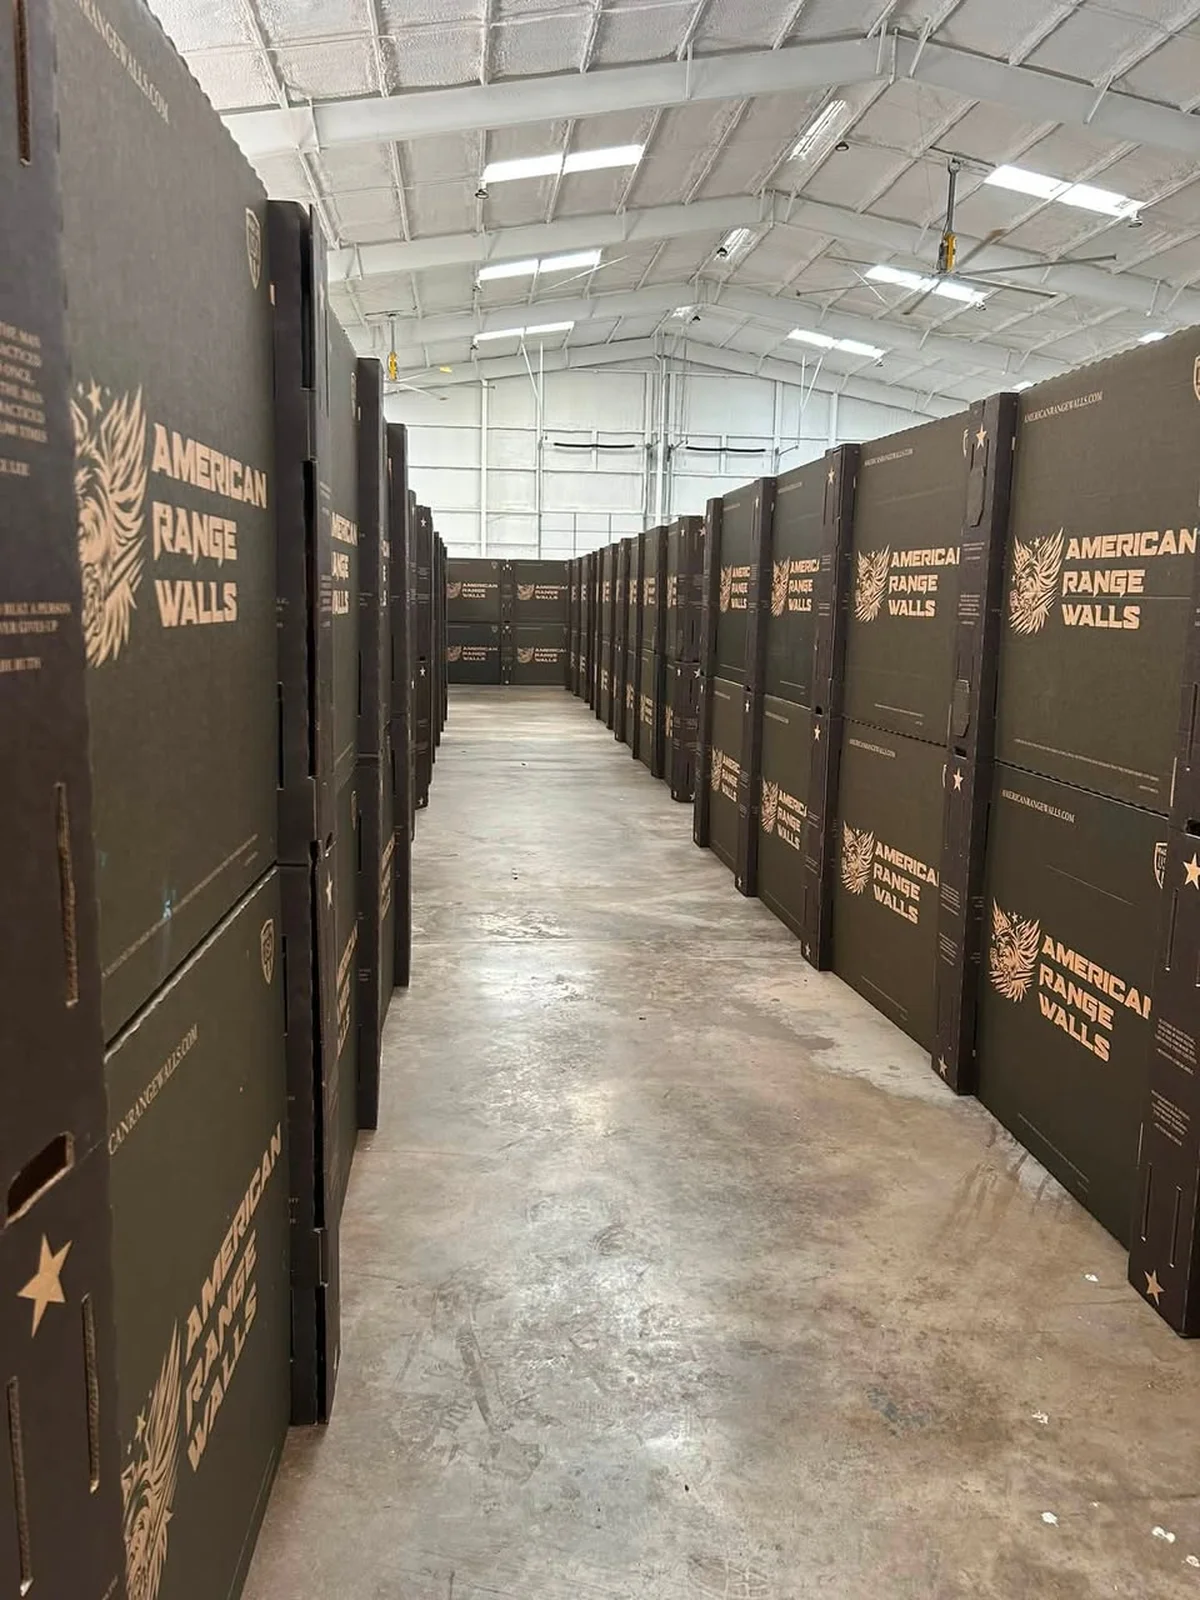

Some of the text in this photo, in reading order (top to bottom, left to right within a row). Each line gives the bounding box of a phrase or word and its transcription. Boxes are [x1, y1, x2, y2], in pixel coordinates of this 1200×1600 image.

[152, 422, 268, 509] AMERICAN
[152, 501, 238, 567] RANGE
[1065, 527, 1197, 560] AMERICAN
[789, 579, 813, 595] RANGE
[889, 574, 938, 594] RANGE
[1061, 569, 1146, 597] RANGE
[155, 579, 238, 628] WALLS
[731, 598, 748, 609] WALLS
[788, 598, 813, 611] WALLS
[888, 599, 936, 617] WALLS
[1061, 605, 1141, 629] WALLS
[777, 806, 801, 833] RANGE
[777, 823, 800, 850] WALLS
[873, 862, 920, 901] RANGE
[875, 840, 939, 887] AMERICA
[873, 884, 918, 924] WALLS
[1039, 962, 1114, 1031] RANGE
[1039, 991, 1110, 1062] WALLS
[186, 1121, 281, 1366] AMERICAN
[187, 1229, 257, 1436] RANGE
[188, 1283, 257, 1472] WALLS
